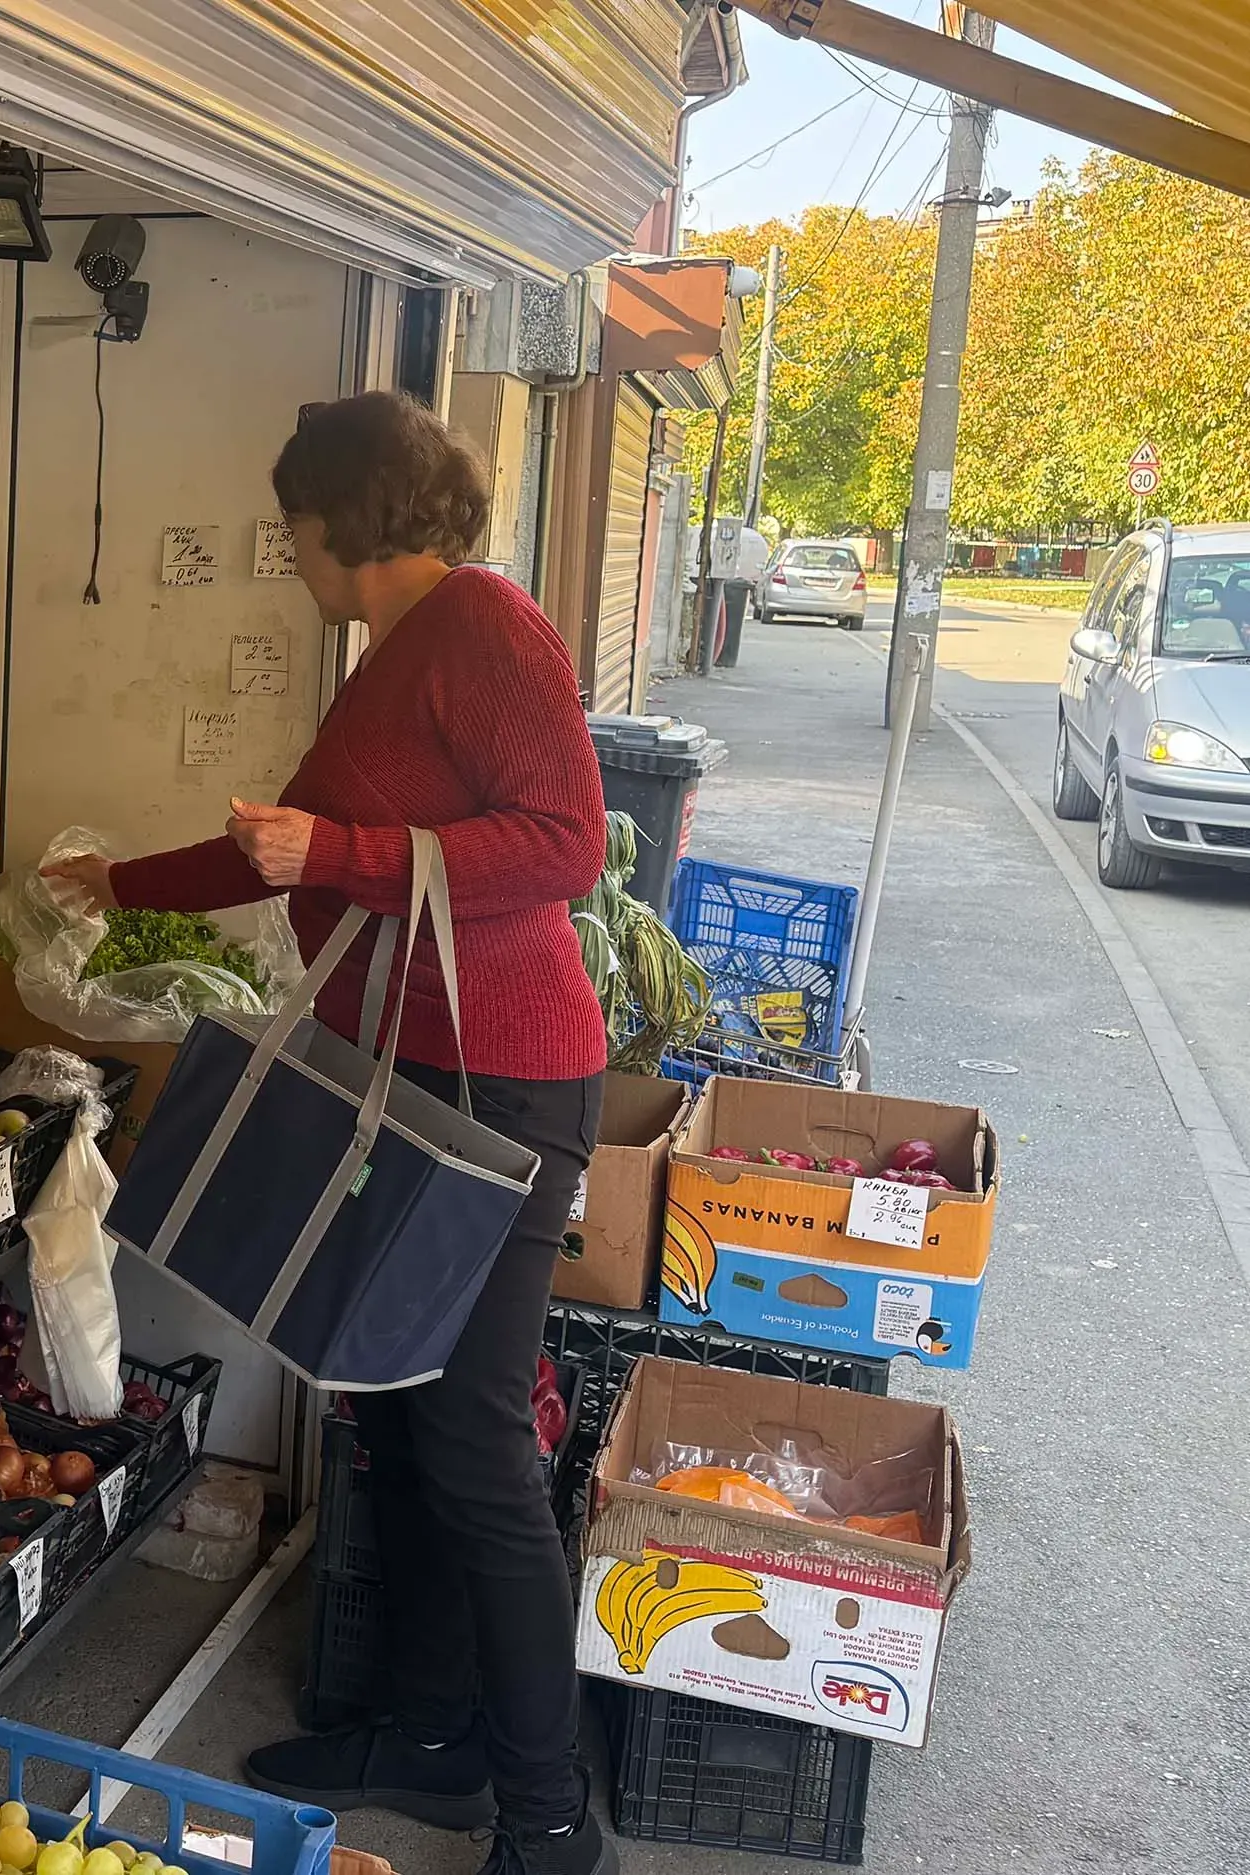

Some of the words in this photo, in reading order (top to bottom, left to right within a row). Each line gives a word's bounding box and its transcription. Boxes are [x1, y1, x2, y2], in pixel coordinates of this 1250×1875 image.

[1134, 473, 1152, 488] 30
[259, 520, 286, 532] Прас
[862, 1181, 909, 1197] КАМБА
[702, 1200, 814, 1230] BANANAS
[882, 1284, 915, 1299] toco
[761, 1313, 802, 1328] Ecuador
[804, 1320, 816, 1331] of
[818, 1322, 859, 1339] Product
[764, 1552, 832, 1578] BANANAS
[835, 1565, 906, 1593] PREMIUM
[878, 1627, 900, 1636] EXTRA
[901, 1631, 923, 1641] CLASS
[843, 1643, 875, 1654] ECUADOR
[907, 1647, 921, 1656] NET
[843, 1650, 877, 1662] BANANAS
[887, 1652, 920, 1663] PRODUCT
[877, 1658, 919, 1671] CAVENDISH
[822, 1681, 890, 1716] Dole
